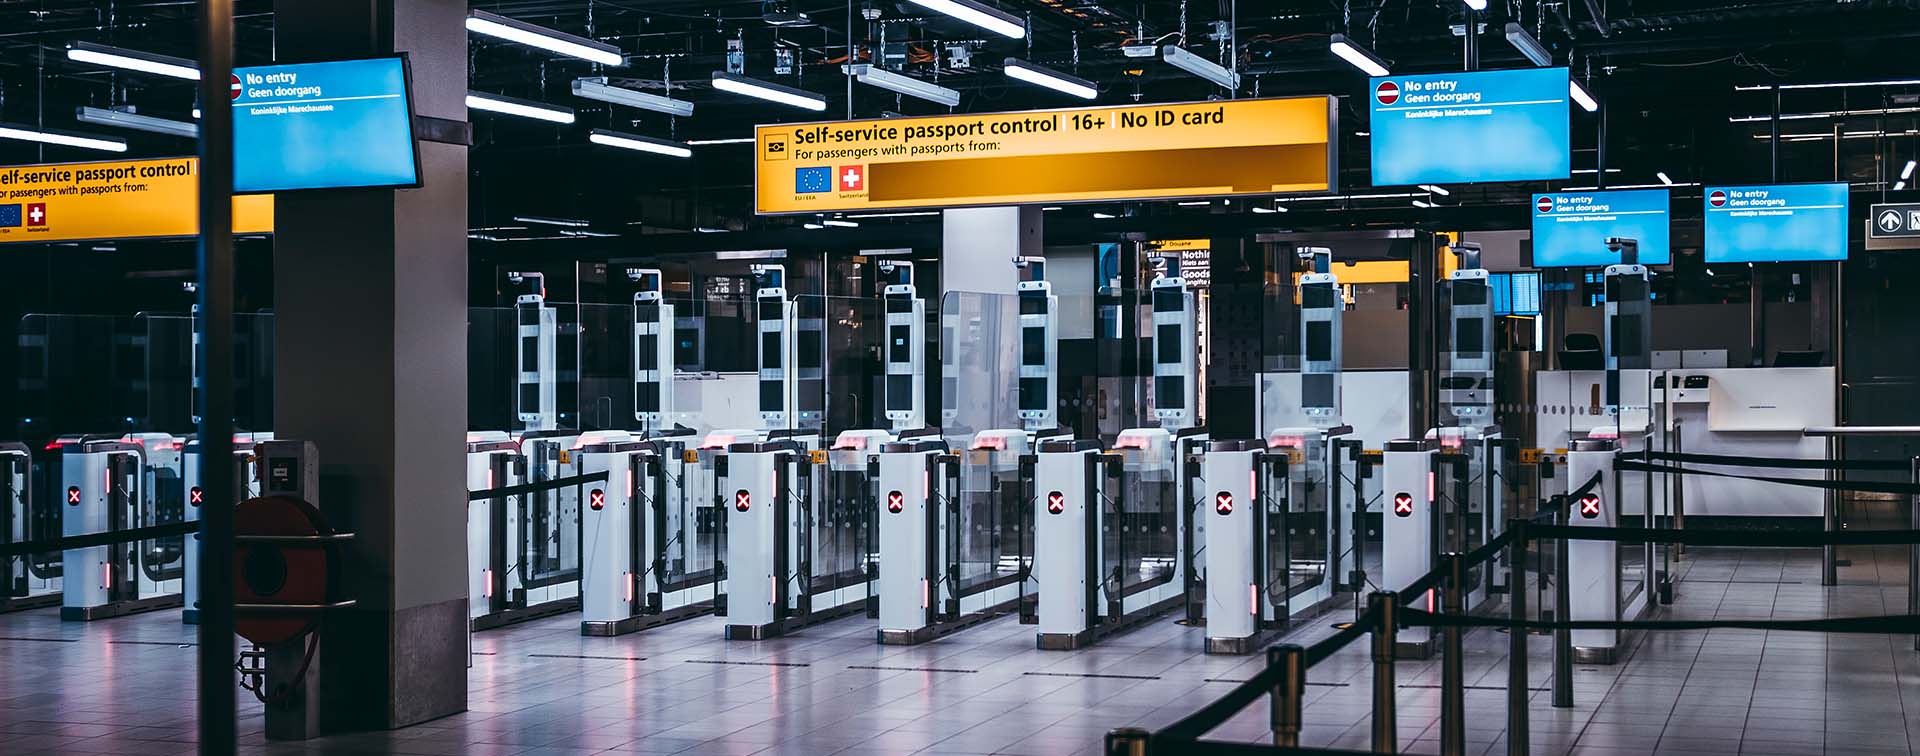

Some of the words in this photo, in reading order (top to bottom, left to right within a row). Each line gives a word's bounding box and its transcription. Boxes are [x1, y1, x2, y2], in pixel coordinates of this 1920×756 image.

[246, 73, 263, 84] No
[265, 72, 297, 84] entry
[1404, 81, 1422, 91] No
[1424, 80, 1457, 91] entry
[248, 88, 273, 98] Geen
[275, 86, 321, 97] doorgang
[1405, 94, 1431, 103] Geen
[1433, 92, 1481, 102] doorgang
[795, 124, 898, 144] Self-service
[904, 120, 985, 142] passport
[991, 114, 1057, 134] control
[1071, 114, 1105, 130] 16+
[1121, 112, 1148, 128] No
[1155, 110, 1175, 126] ID
[1182, 106, 1224, 125] card
[795, 149, 813, 160] For
[816, 146, 878, 161] passengers
[881, 144, 907, 155] with
[911, 142, 965, 157] passports
[969, 139, 1001, 152] from:
[0, 168, 71, 185] elf-service
[75, 165, 137, 185] passport
[140, 161, 190, 178] control
[0, 189, 8, 199] or
[10, 187, 57, 200] passengers
[58, 184, 78, 196] with
[80, 182, 122, 196] passports
[123, 182, 148, 192] from:
[1730, 190, 1743, 198] No
[1744, 190, 1768, 199] entry
[1556, 196, 1569, 204] No
[1570, 196, 1593, 205] entry
[1730, 199, 1749, 207] Geen
[1750, 198, 1786, 207] doorgang
[1575, 203, 1609, 213] doorgang
[1182, 270, 1210, 279] Goods
[1184, 279, 1207, 287] angifte
